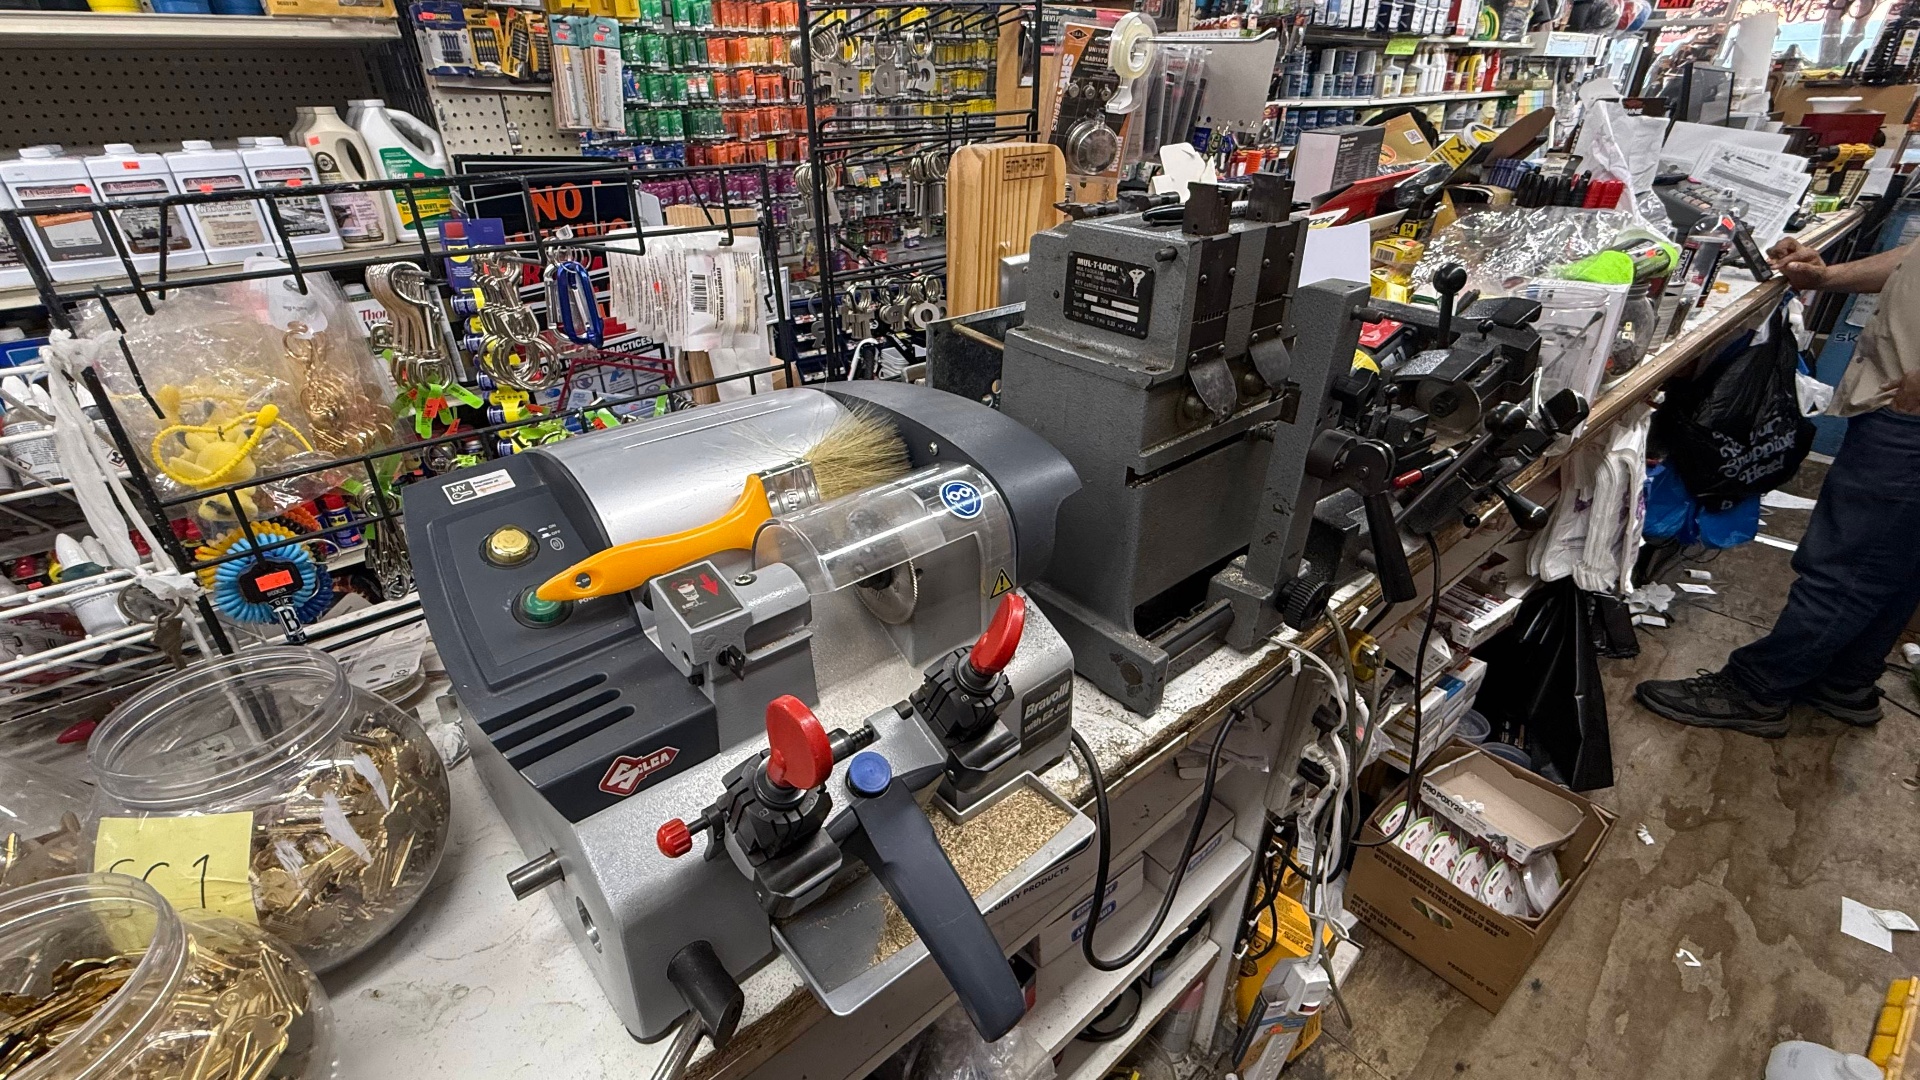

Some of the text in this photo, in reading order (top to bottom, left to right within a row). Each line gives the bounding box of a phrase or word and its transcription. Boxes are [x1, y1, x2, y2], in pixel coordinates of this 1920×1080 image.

[1084, 55, 1108, 64] RADIATO
[1050, 95, 1063, 132] SERIES
[530, 182, 583, 222] NO
[1404, 223, 1413, 233] 14
[1076, 257, 1118, 273] MUL-T-LOCK
[1718, 430, 1797, 478] Shopping
[451, 484, 467, 493] MY
[1024, 717, 1042, 733] with
[1042, 708, 1055, 722] EZ
[606, 752, 670, 790] SILCA
[1422, 781, 1437, 796] PRO
[1022, 864, 1070, 896] PRODUCTS
[1374, 852, 1388, 867] WITH
[1393, 865, 1408, 878] FOOD
[1408, 874, 1428, 892] GRADE
[1427, 888, 1462, 915] PETROLEUM
[1462, 911, 1484, 928] BASED
[1483, 925, 1499, 938] WAX
[1402, 861, 1434, 888] FRESHNESS
[1434, 881, 1449, 897] THIS
[1449, 892, 1476, 915] PRODUCT
[1477, 911, 1485, 922] IS
[1485, 916, 1510, 937] COATED
[1350, 899, 1361, 910] NET
[1361, 905, 1369, 914] WT
[1383, 911, 1402, 931] BELOW
[1476, 978, 1485, 989] OF
[1485, 985, 1499, 997] USA
